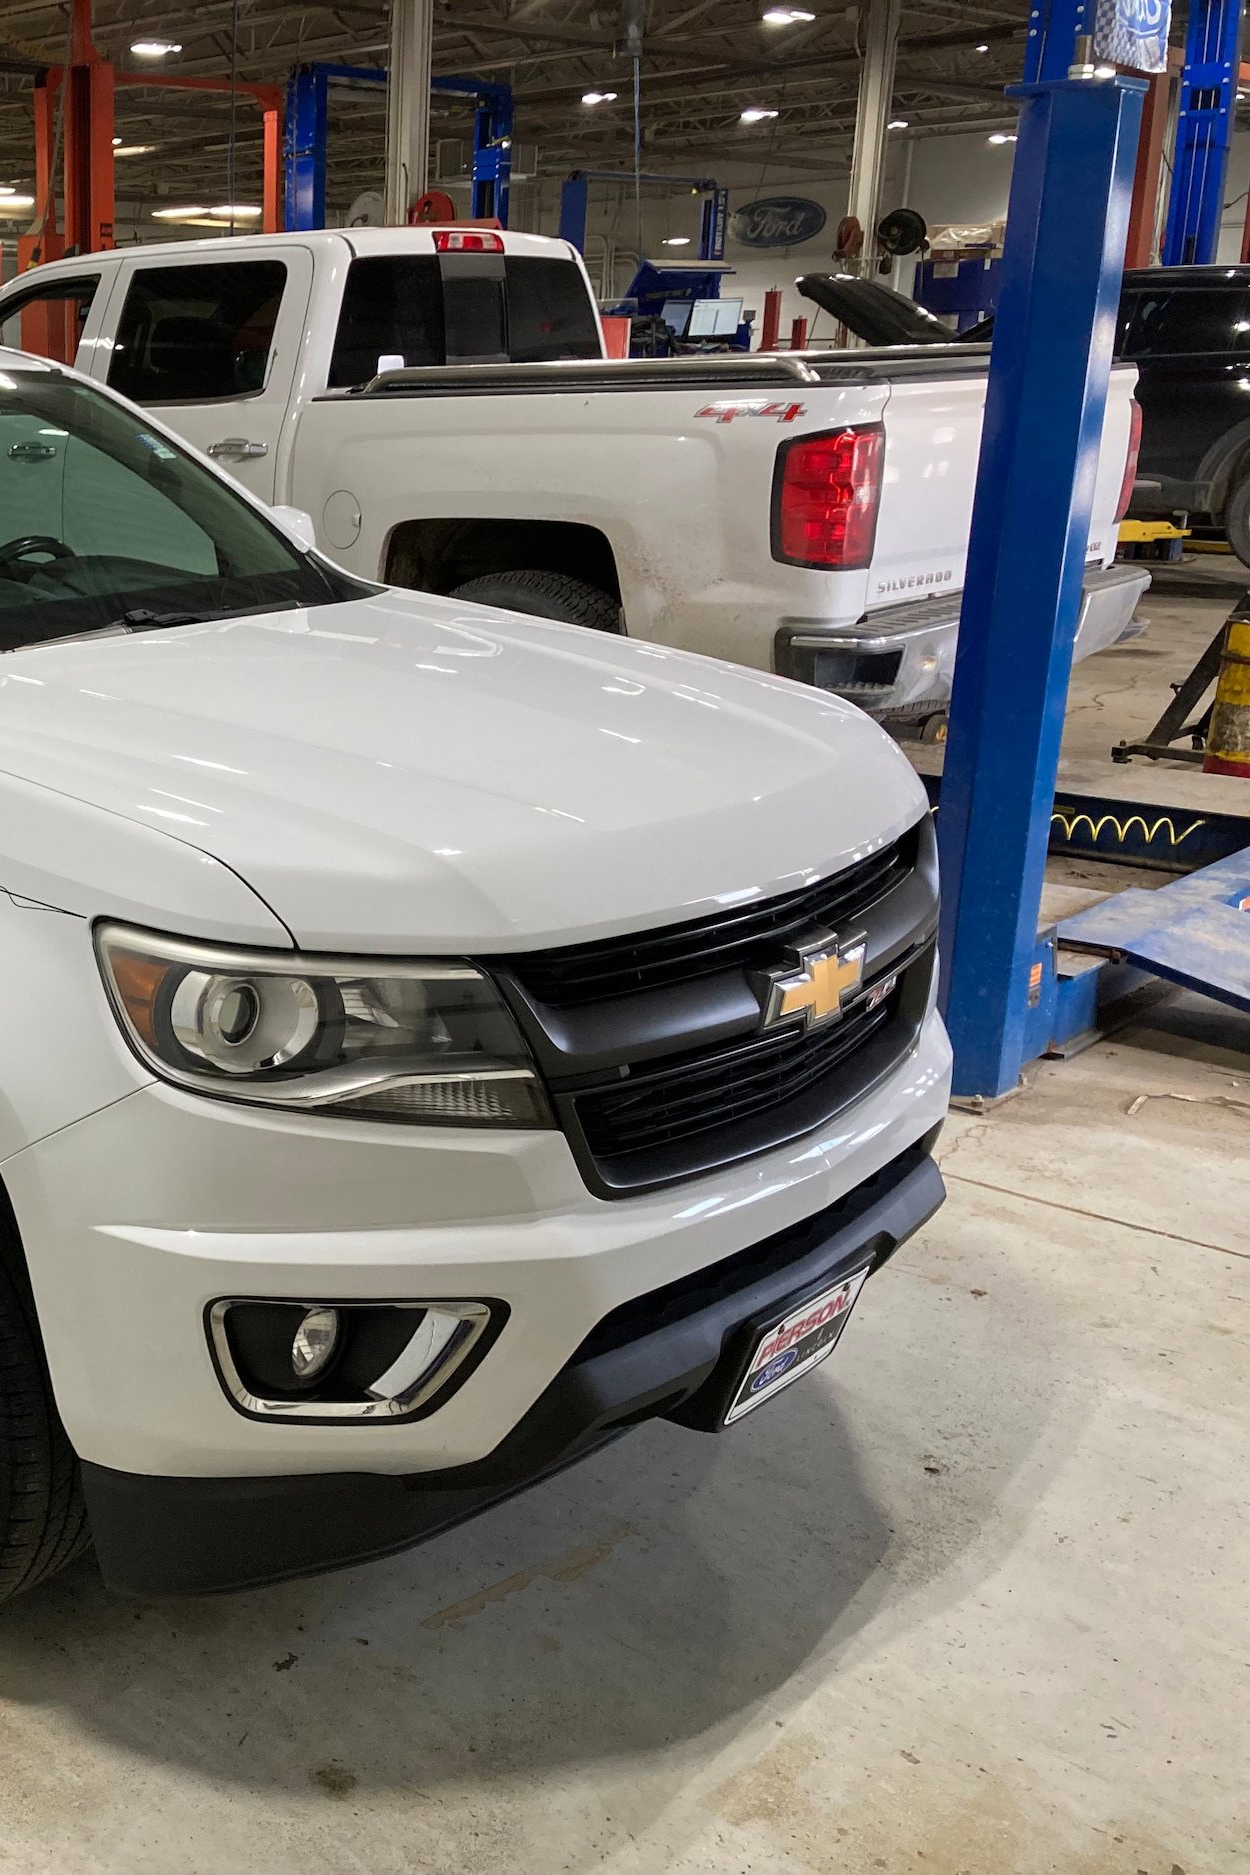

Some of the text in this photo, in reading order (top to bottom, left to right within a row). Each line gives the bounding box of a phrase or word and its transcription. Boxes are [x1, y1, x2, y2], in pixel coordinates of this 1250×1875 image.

[746, 204, 806, 239] Ford
[876, 569, 953, 594] SILVERADO
[756, 1288, 851, 1368] PIERSON
[796, 1331, 834, 1363] LINCOLN
